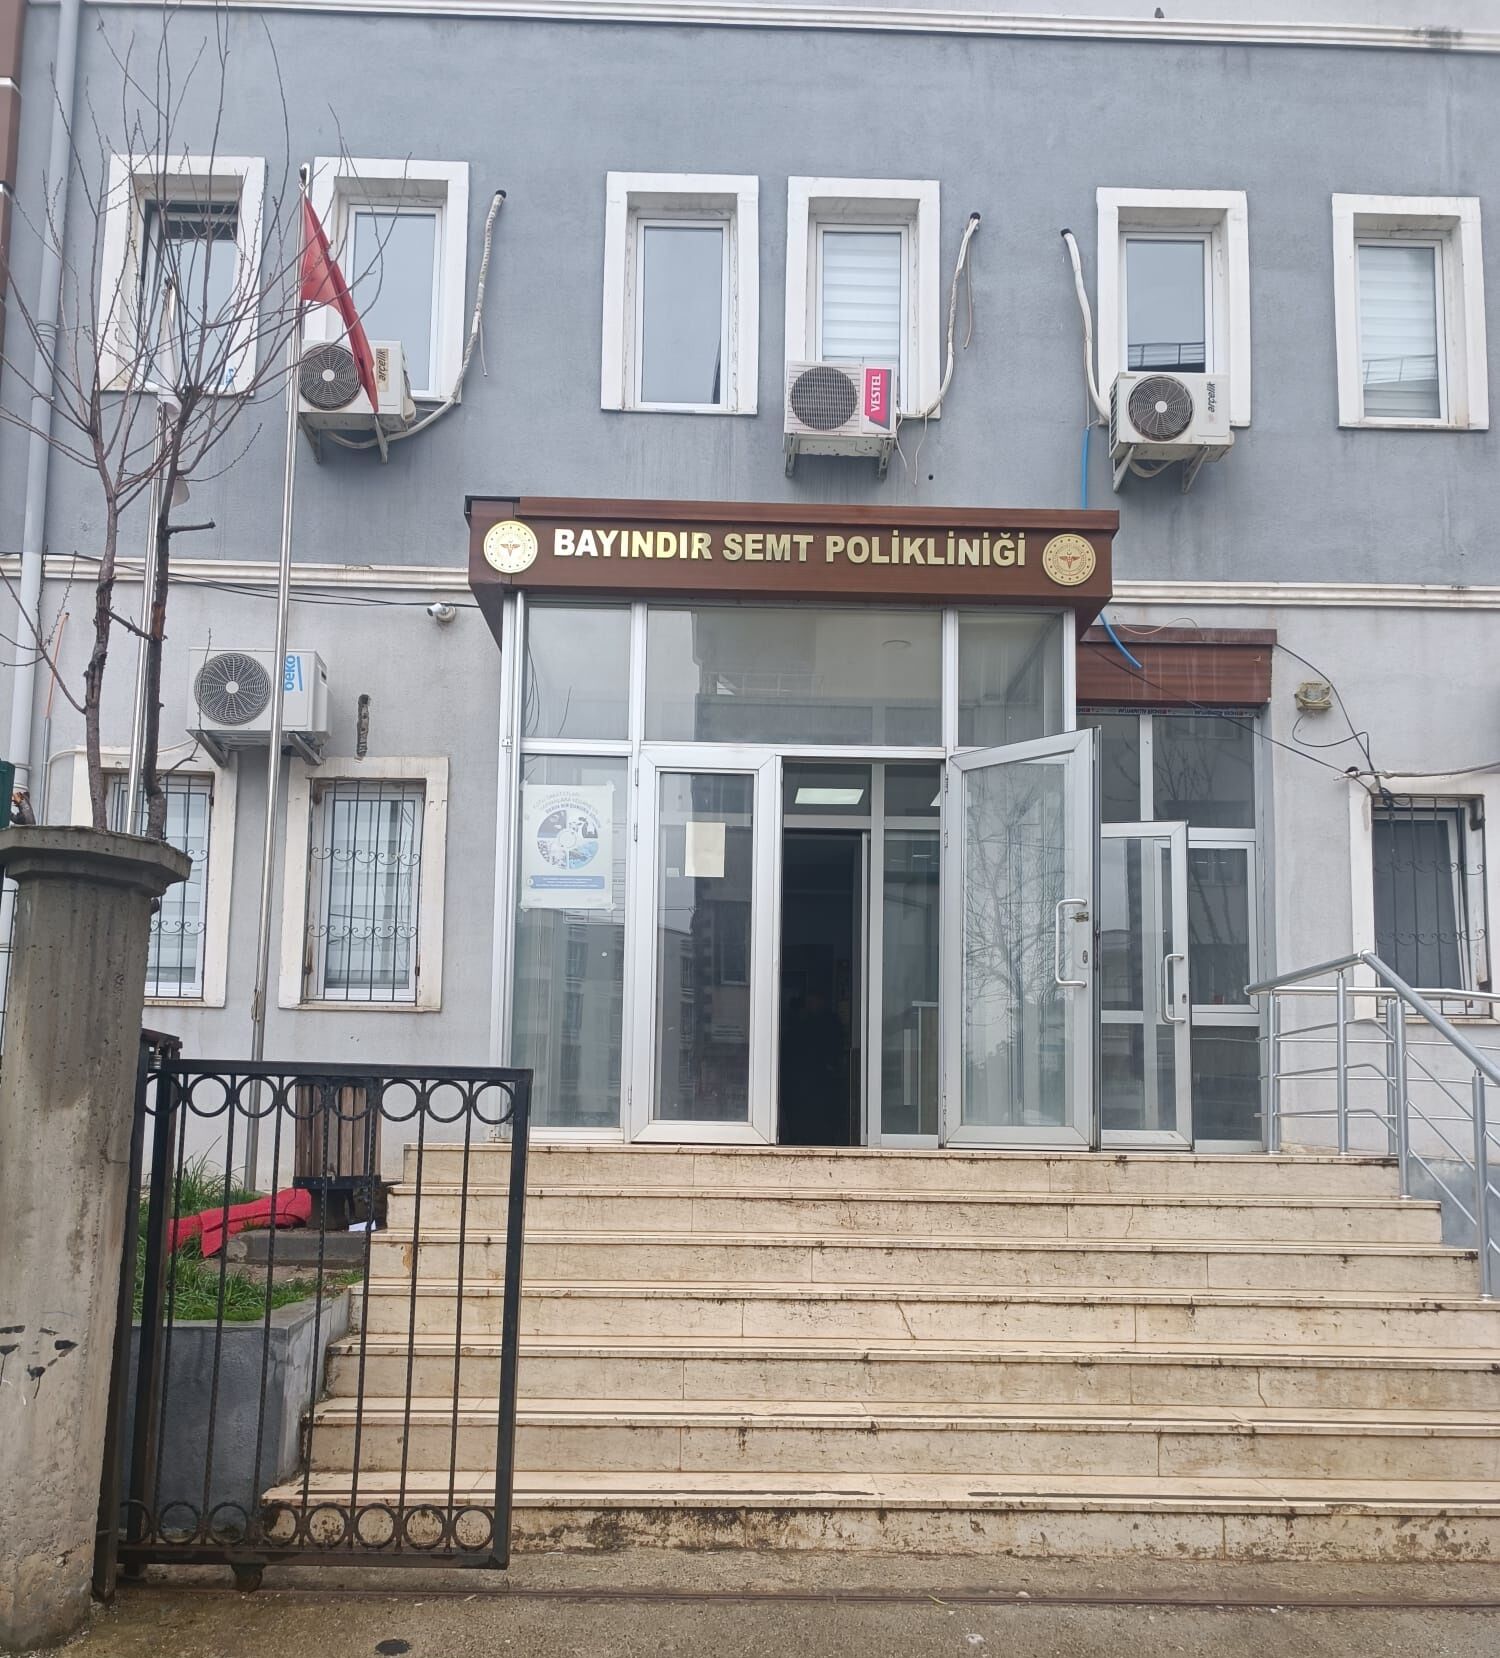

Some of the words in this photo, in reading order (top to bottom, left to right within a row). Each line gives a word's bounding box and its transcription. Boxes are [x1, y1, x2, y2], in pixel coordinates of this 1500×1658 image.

[870, 373, 881, 412] VESTEL
[553, 528, 713, 560] BAYINDIR
[723, 533, 814, 561] SEMT
[825, 530, 1026, 566] POLİKLİNİĞİ
